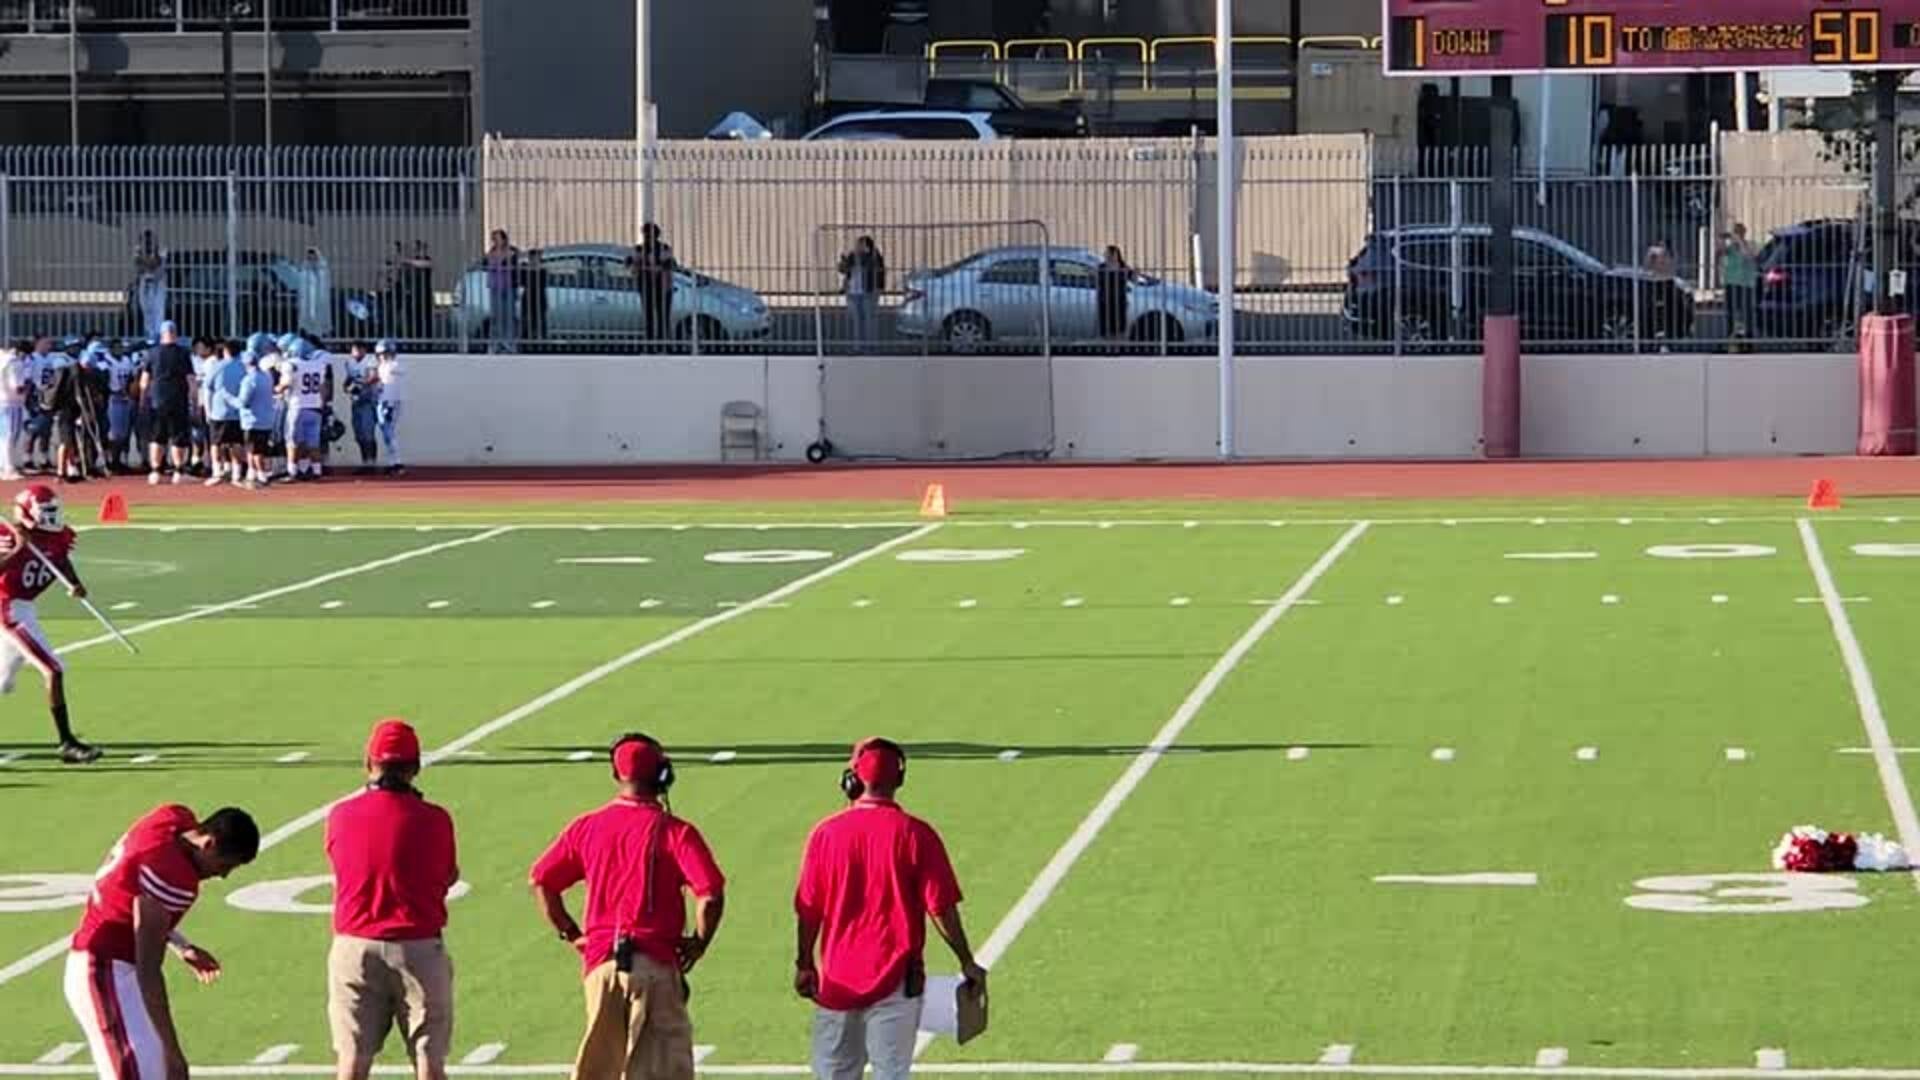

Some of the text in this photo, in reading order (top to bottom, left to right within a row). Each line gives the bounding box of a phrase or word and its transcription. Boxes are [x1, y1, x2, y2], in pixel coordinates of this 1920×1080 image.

[1433, 31, 1489, 54] DOWN
[1569, 16, 1612, 65] 10
[1622, 27, 1649, 51] TO
[1813, 11, 1878, 61] 50
[301, 372, 321, 395] 98
